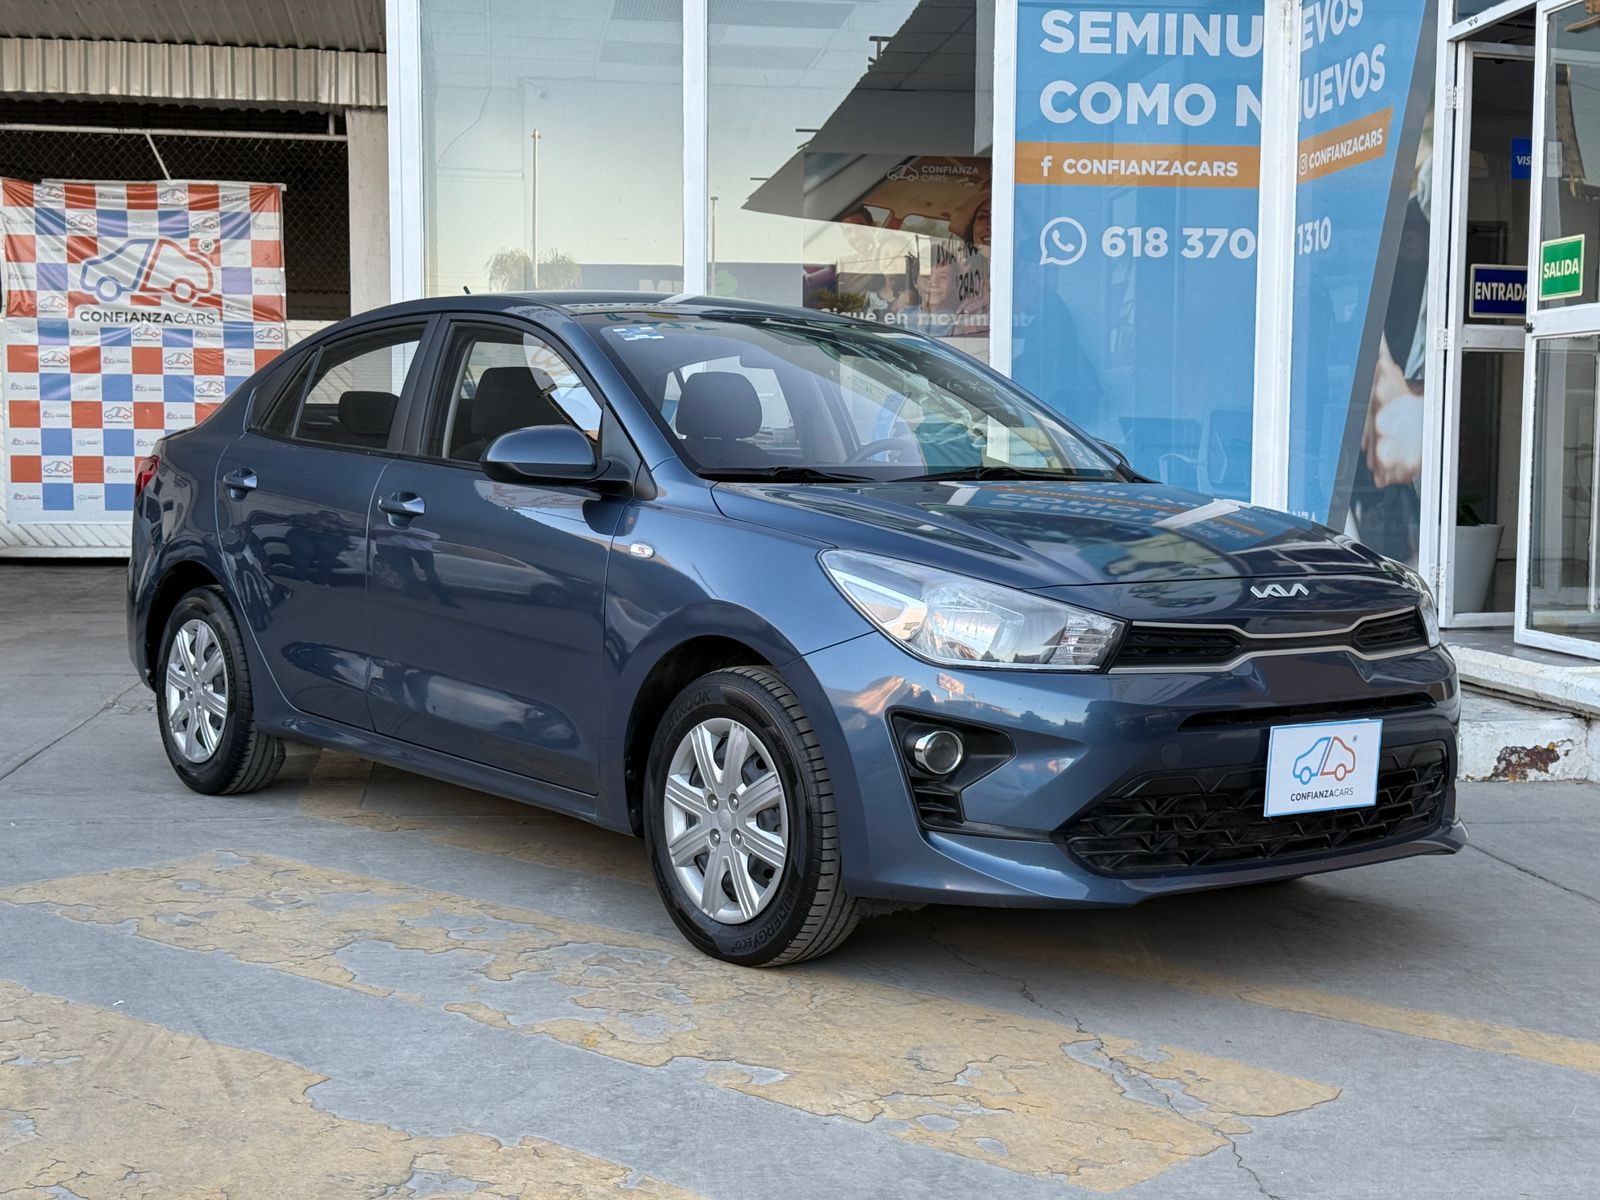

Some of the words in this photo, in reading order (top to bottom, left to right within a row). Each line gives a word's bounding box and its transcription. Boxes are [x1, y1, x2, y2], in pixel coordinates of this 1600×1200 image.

[1040, 9, 1264, 57] SEMINU
[1299, 43, 1386, 122] UEVOS
[1040, 80, 1216, 126] COMO
[1309, 128, 1383, 169] CONFIANZACARS
[921, 165, 980, 175] CONFIANZA
[1063, 159, 1238, 177] CONFIANZACARS
[1101, 225, 1168, 258] 618
[1180, 227, 1256, 259] 370
[1297, 216, 1332, 255] 1310
[1543, 258, 1579, 279] SALIDA
[1475, 281, 1528, 301] ENTRADA
[80, 311, 216, 325] CONFIANZACARS
[883, 311, 908, 326] en
[1290, 787, 1354, 802] CONFIANZACARS
